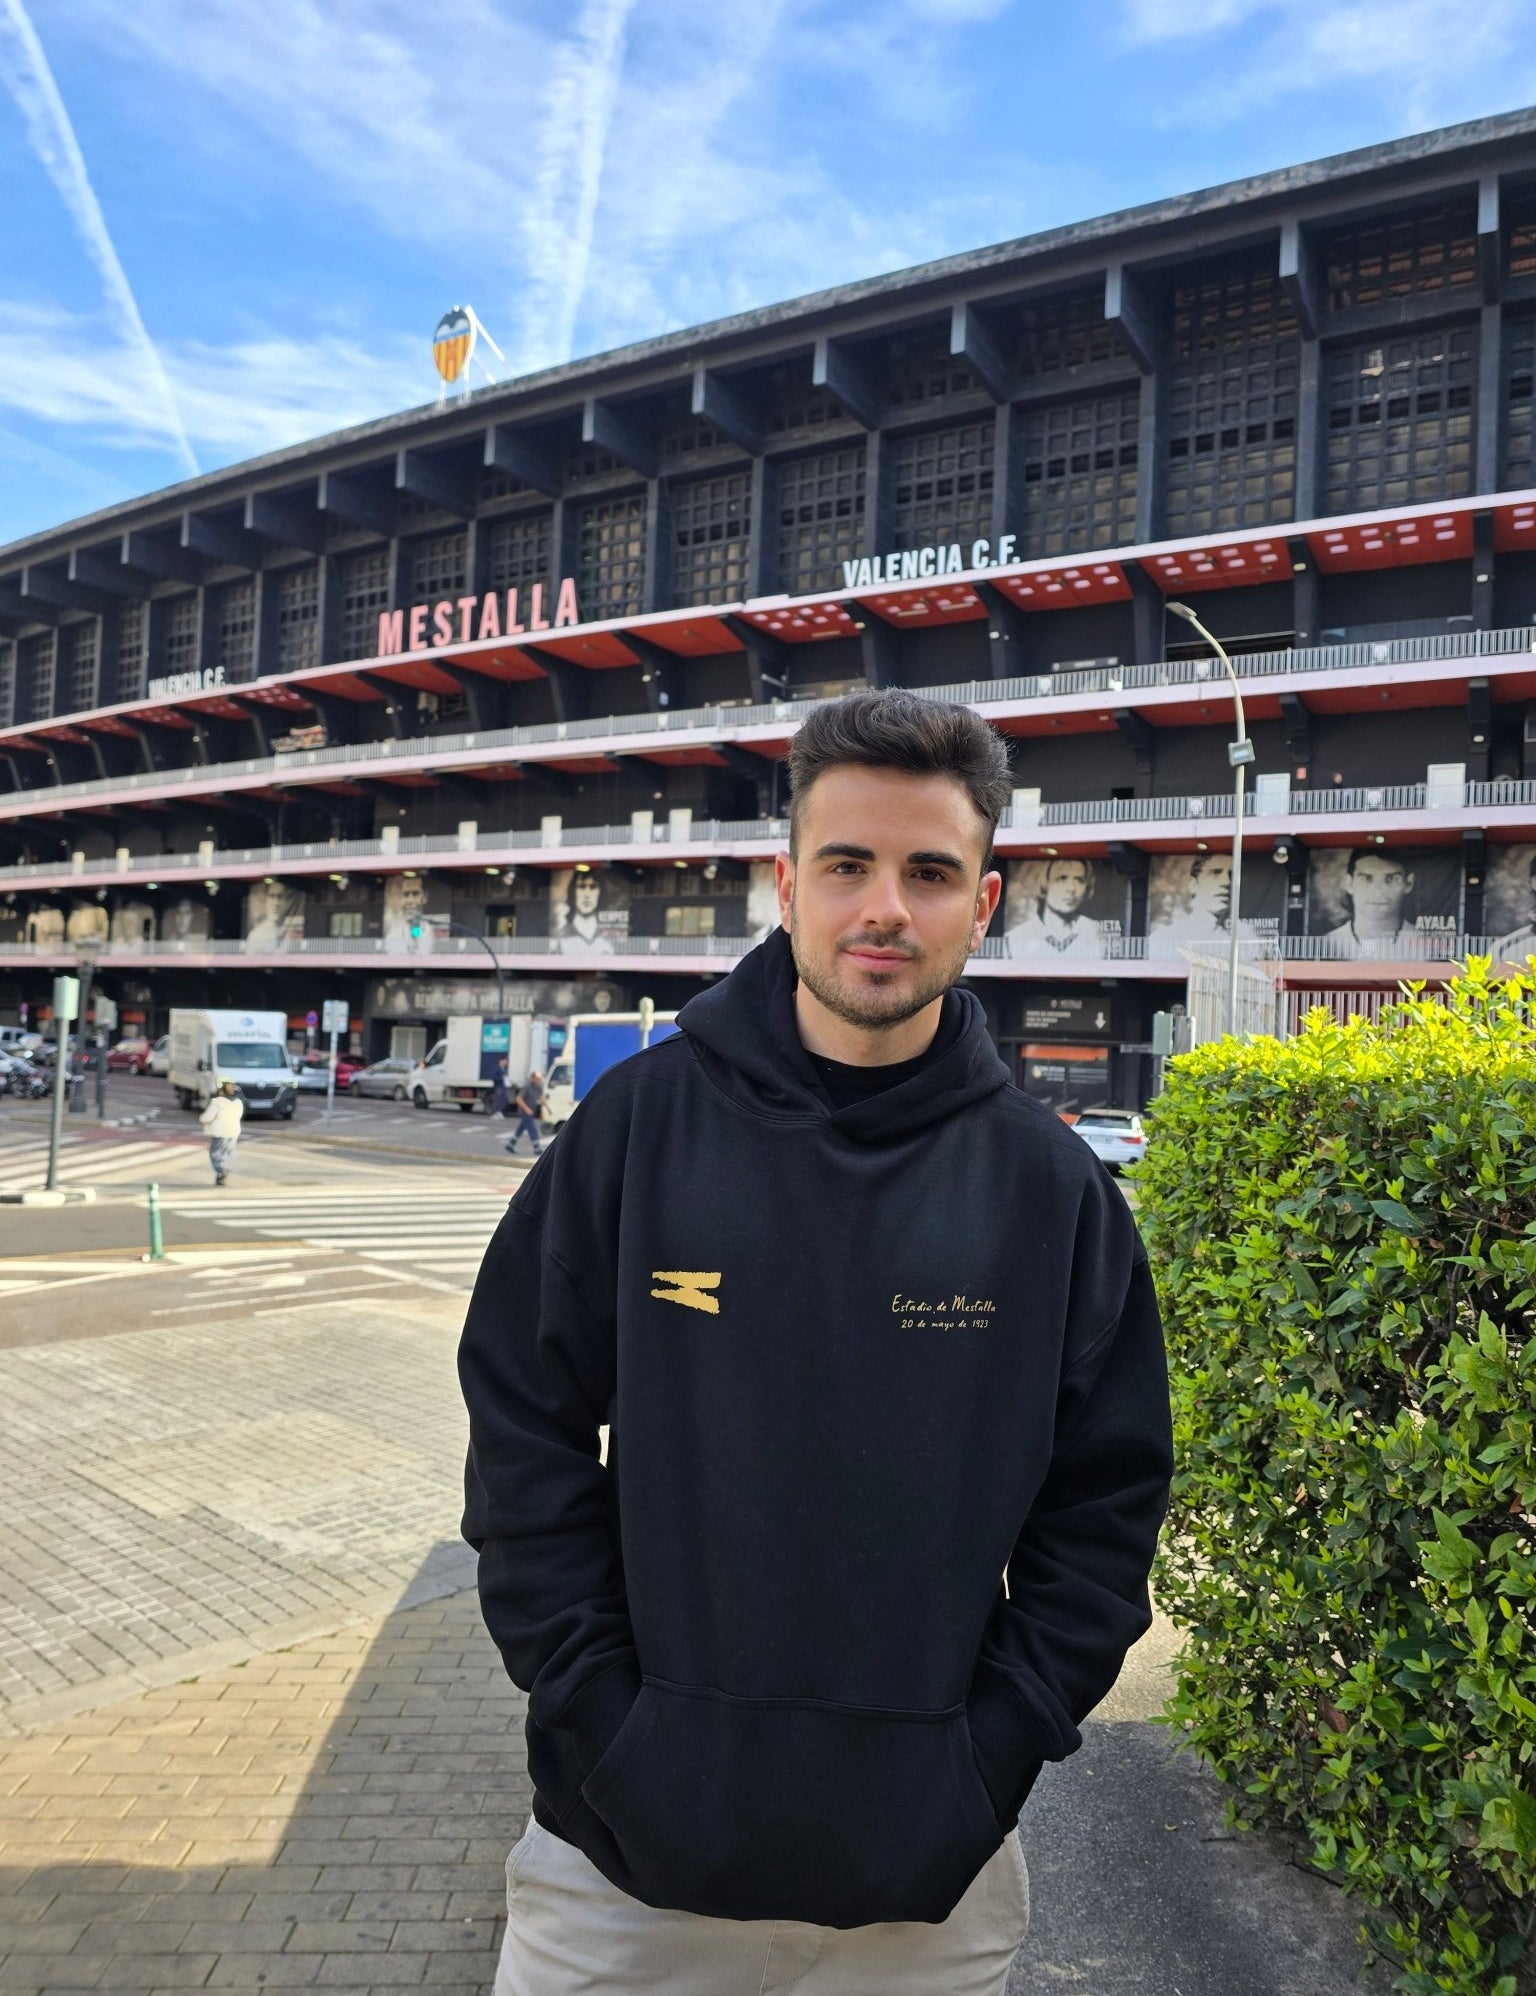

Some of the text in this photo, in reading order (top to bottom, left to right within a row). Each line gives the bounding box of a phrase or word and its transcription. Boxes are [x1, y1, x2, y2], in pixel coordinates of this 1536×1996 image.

[842, 534, 1021, 588] VALENCIA C.F.
[377, 577, 579, 657] MESTALLA
[1223, 917, 1280, 929] CLRAMUNT
[1414, 915, 1457, 930] AYALA
[891, 1293, 996, 1312] Estadio de Mestalla
[901, 1319, 989, 1331] 20 de mayo de 1923
